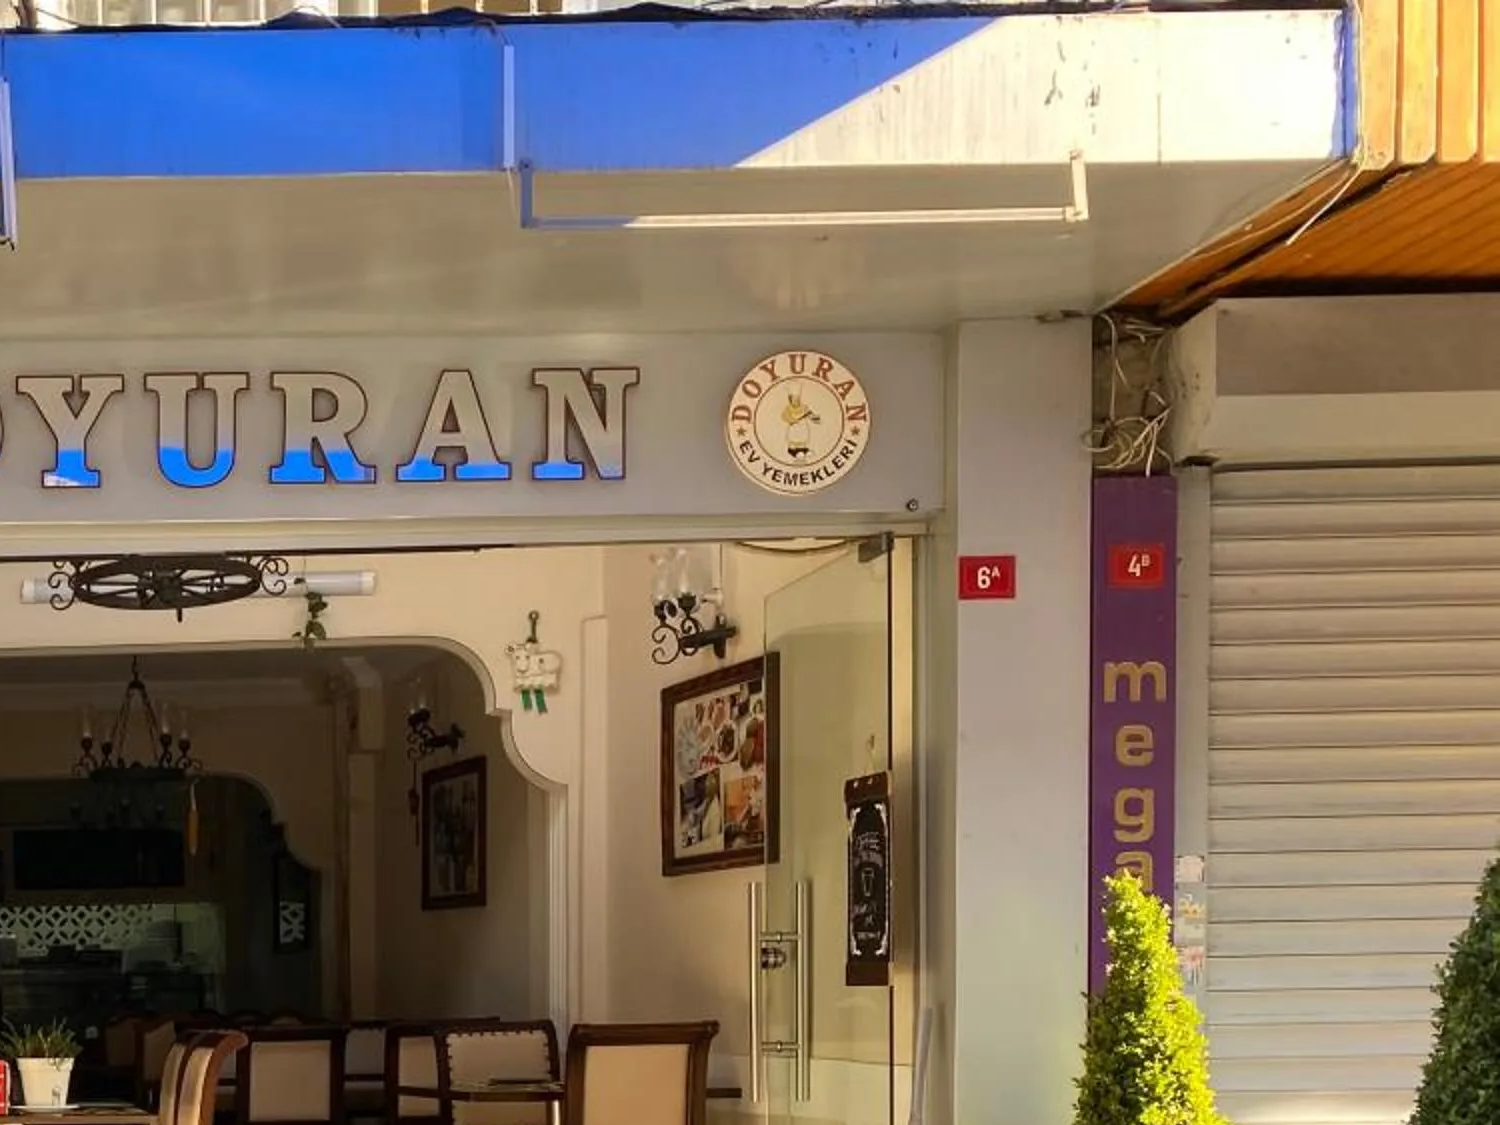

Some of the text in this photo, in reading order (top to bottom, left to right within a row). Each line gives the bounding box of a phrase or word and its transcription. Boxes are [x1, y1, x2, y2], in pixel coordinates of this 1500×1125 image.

[731, 353, 868, 425] DOYURAN
[739, 439, 762, 465] EV
[977, 565, 1001, 589] 6A
